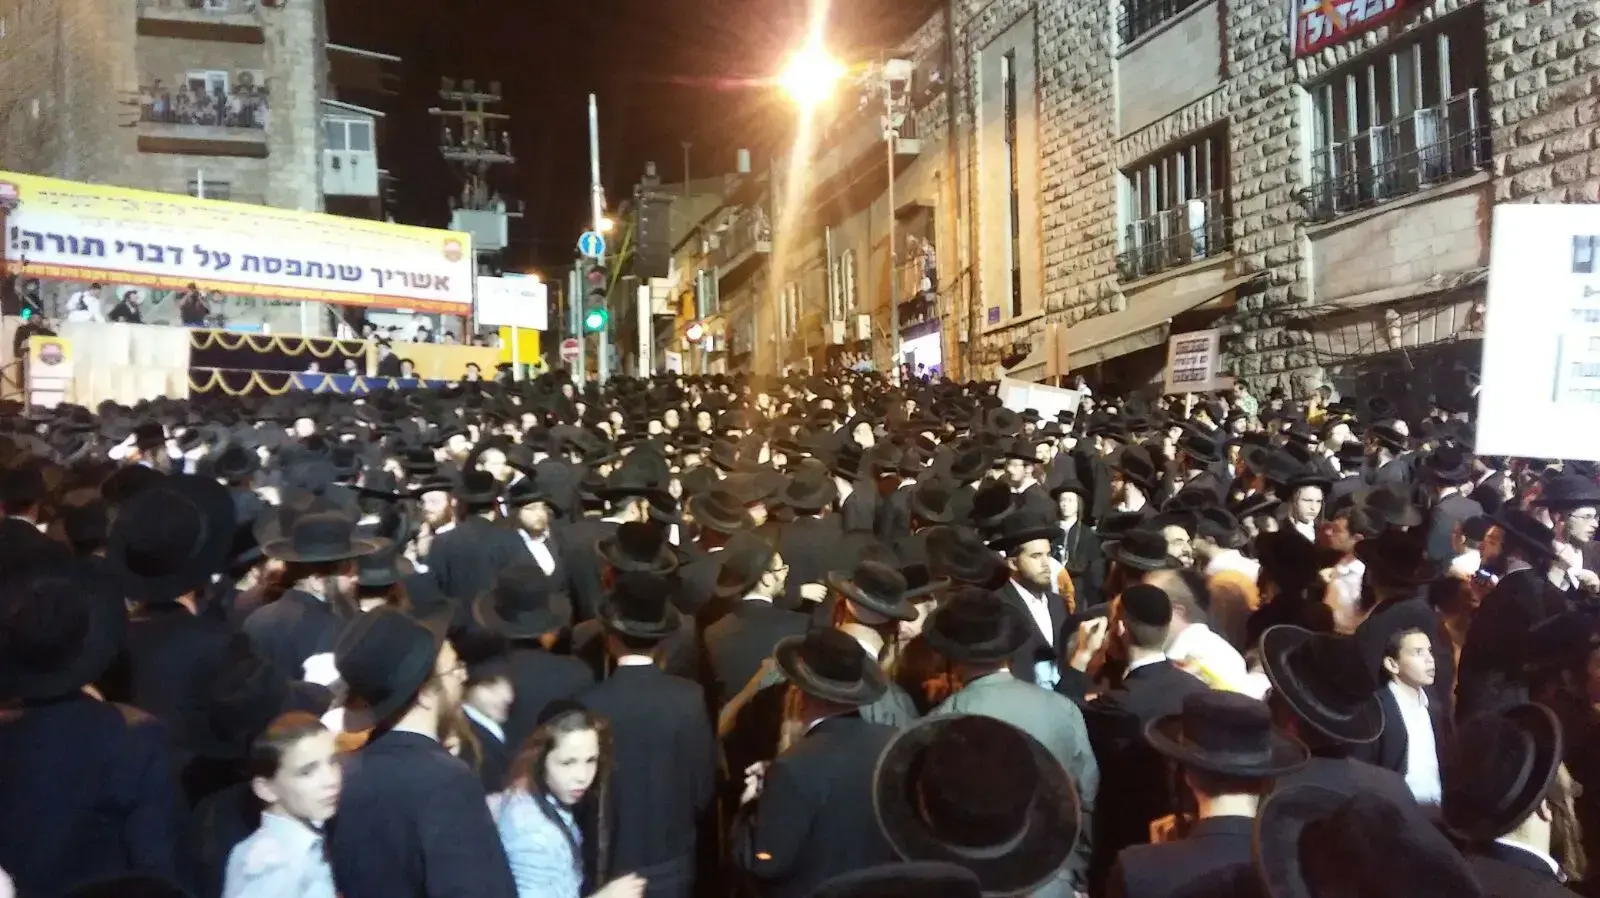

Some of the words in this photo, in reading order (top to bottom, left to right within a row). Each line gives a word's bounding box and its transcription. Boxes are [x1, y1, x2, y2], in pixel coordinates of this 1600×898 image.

[10, 225, 105, 257] תורה!
[114, 239, 184, 265] דברי
[192, 243, 232, 270] על
[240, 253, 362, 282] שנתפסת
[370, 266, 451, 292] אשריך
